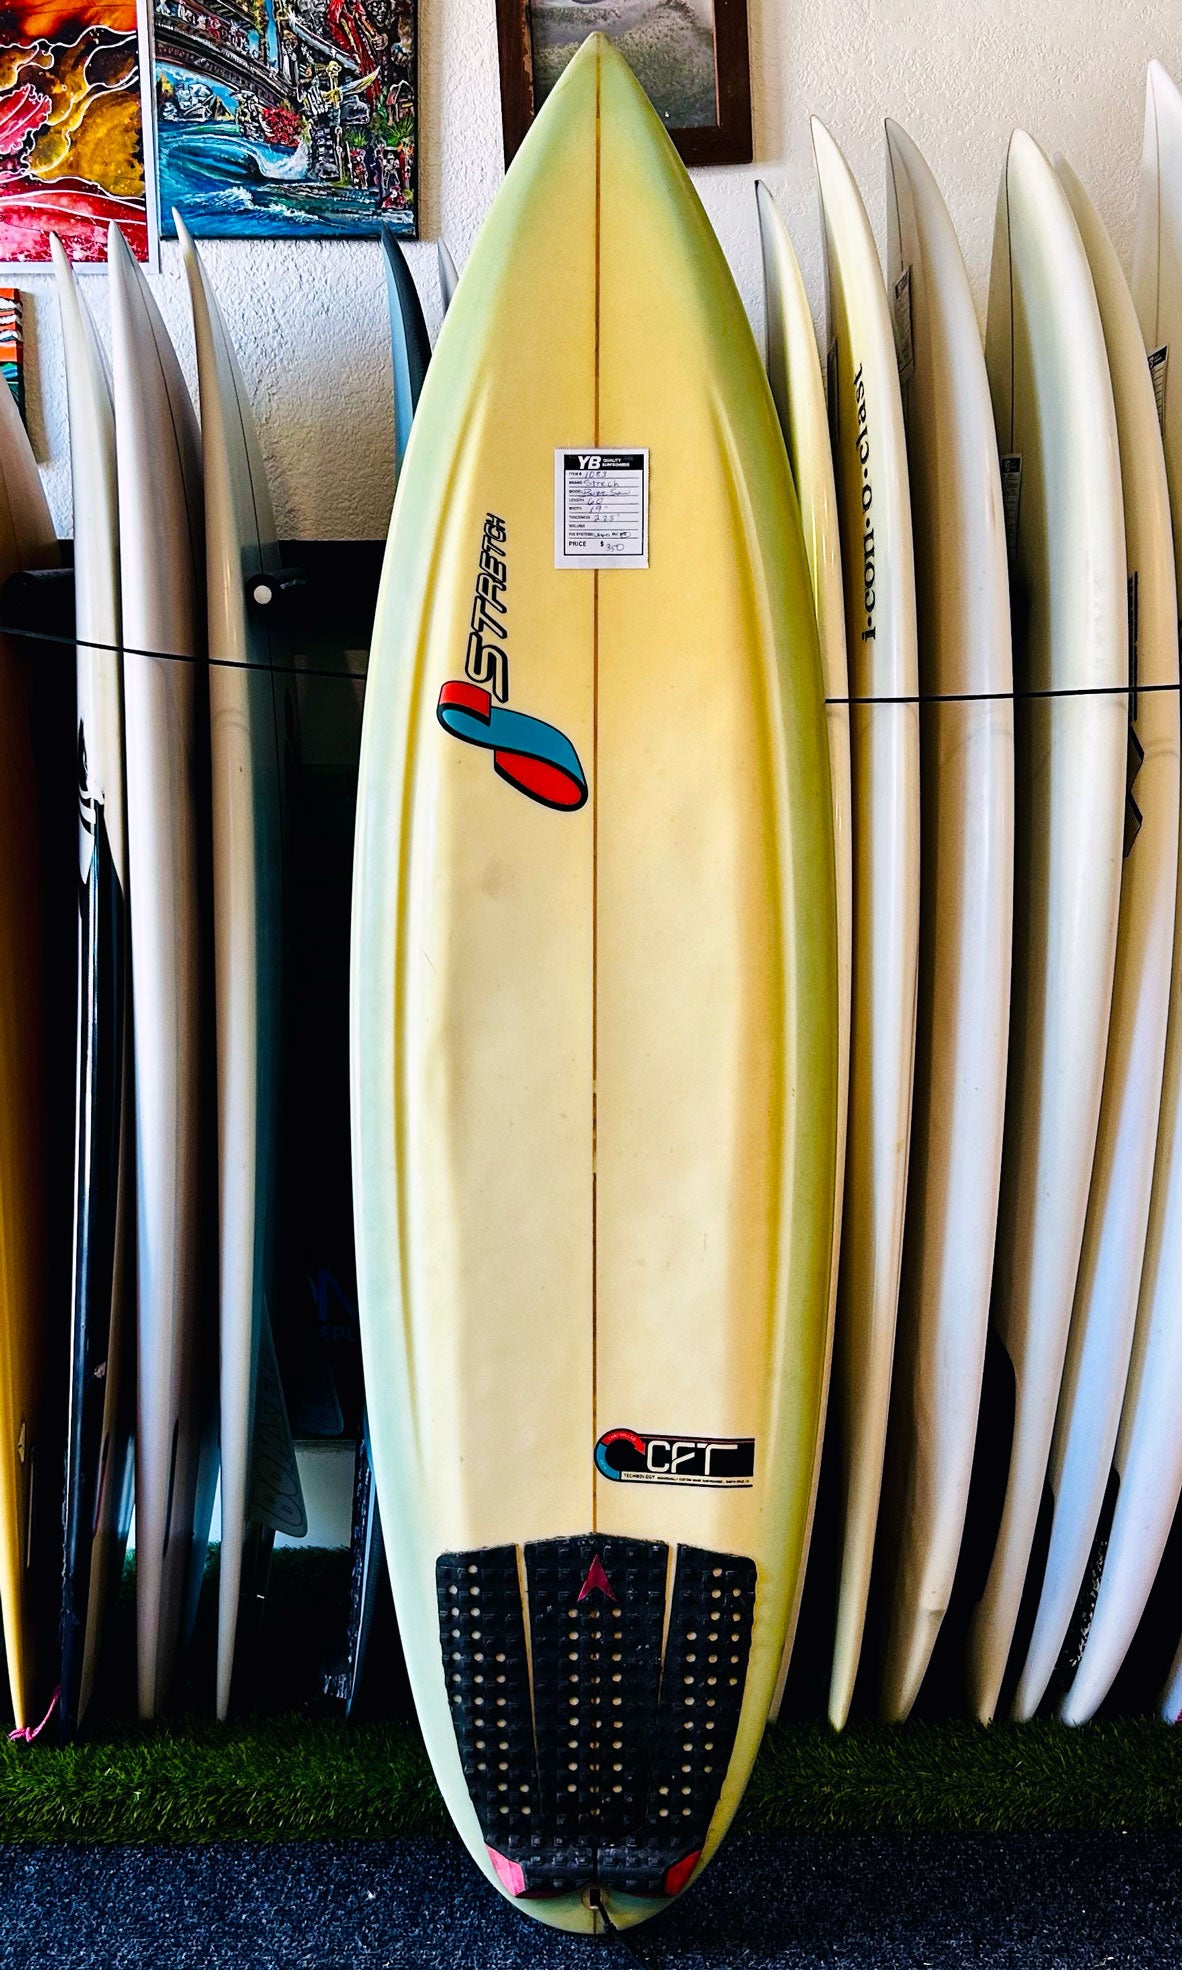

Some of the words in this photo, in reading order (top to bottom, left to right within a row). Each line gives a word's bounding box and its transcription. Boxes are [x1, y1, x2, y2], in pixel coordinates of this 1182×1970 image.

[577, 455, 602, 470] YB
[606, 543, 625, 552] 350
[465, 512, 509, 703] STRETCH
[646, 1440, 739, 1476] CFT
